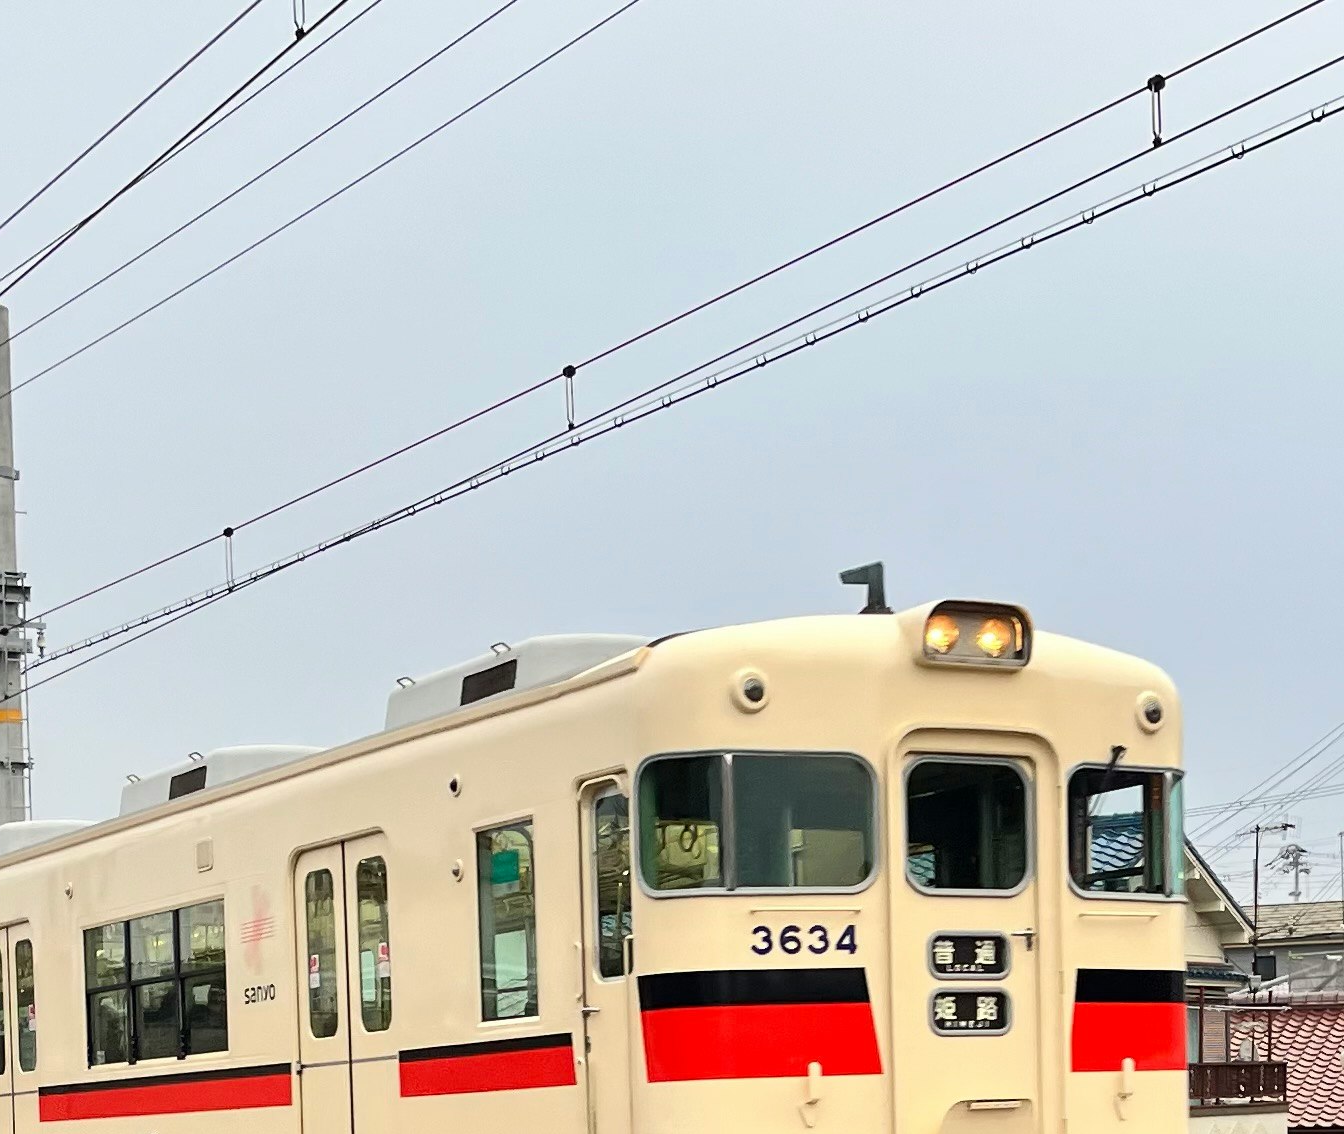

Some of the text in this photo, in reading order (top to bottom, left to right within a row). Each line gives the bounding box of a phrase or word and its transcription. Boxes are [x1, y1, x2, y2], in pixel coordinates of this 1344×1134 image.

[752, 924, 858, 955] 3634
[933, 940, 996, 965] 普通
[244, 983, 276, 1005] sanyo
[935, 996, 997, 1020] 姫路
